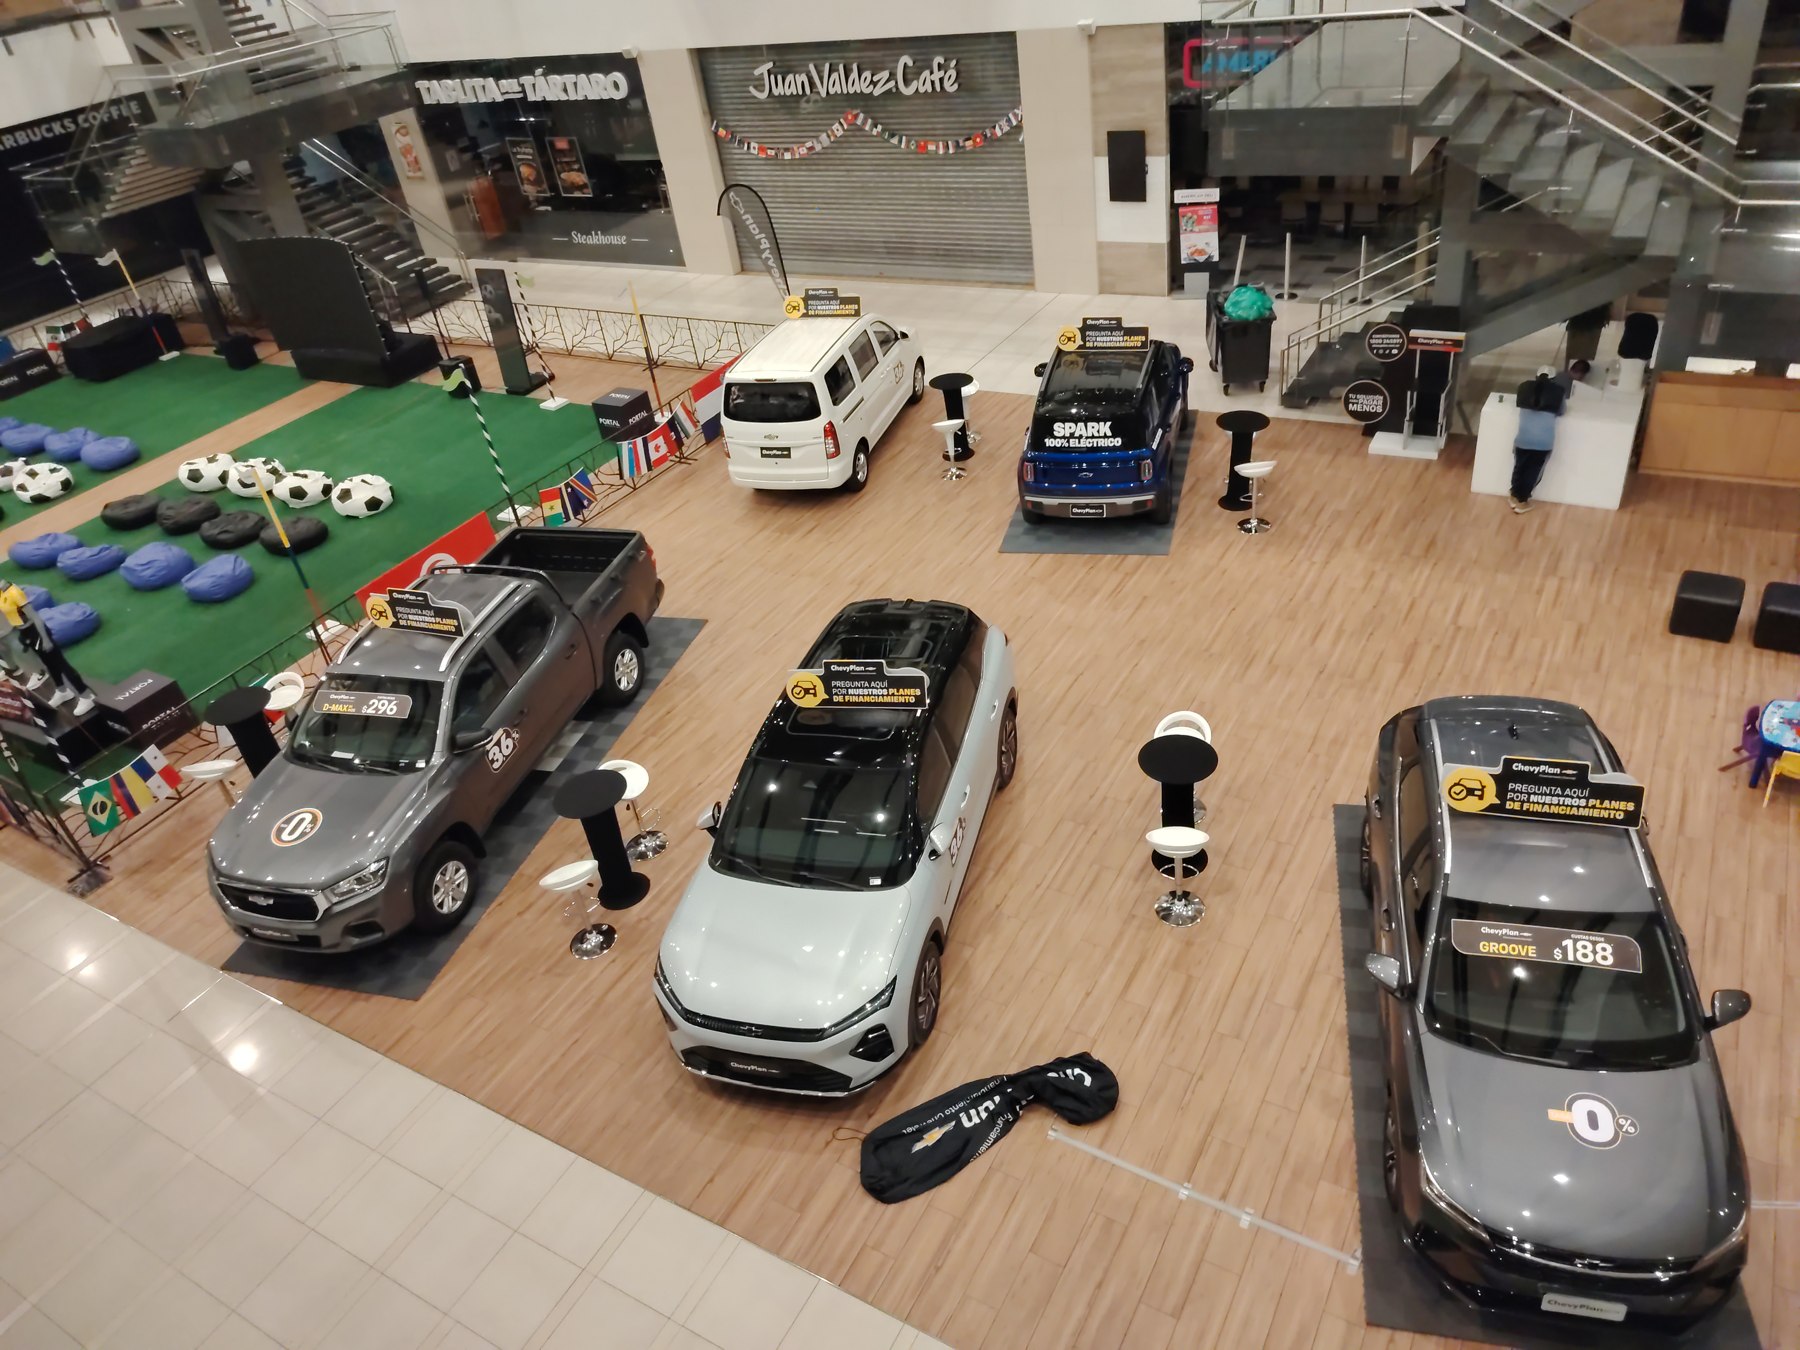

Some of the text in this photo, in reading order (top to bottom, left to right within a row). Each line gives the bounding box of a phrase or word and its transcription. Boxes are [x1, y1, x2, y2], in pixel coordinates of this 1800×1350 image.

[750, 54, 959, 99] Juan Valdez Café
[415, 77, 504, 104] TABLITA
[519, 66, 628, 101] TÁRTARO
[571, 230, 627, 245] Steakhouse
[1348, 404, 1382, 412] MENOS
[599, 418, 620, 427] PORTAL
[1053, 421, 1112, 437] SPARK
[1044, 436, 1122, 447] 100% ELÉCTRICO
[830, 664, 865, 672] ChevyPlan
[870, 680, 888, 689] AQUÍ
[889, 688, 921, 696] PLANES
[322, 703, 348, 712] D-MAX
[362, 699, 398, 715] $296
[1512, 762, 1560, 774] ChevyPlan
[1508, 783, 1590, 798] PREGUNTA AQUÍ
[1507, 792, 1635, 811] POR NUESTROS PLANES
[1505, 801, 1625, 820] DE FINANCIAMIENTO
[1480, 926, 1519, 936] ChevyPlan
[1479, 939, 1614, 966] GROOVE $188
[1546, 1299, 1604, 1312] ChevyPlan
